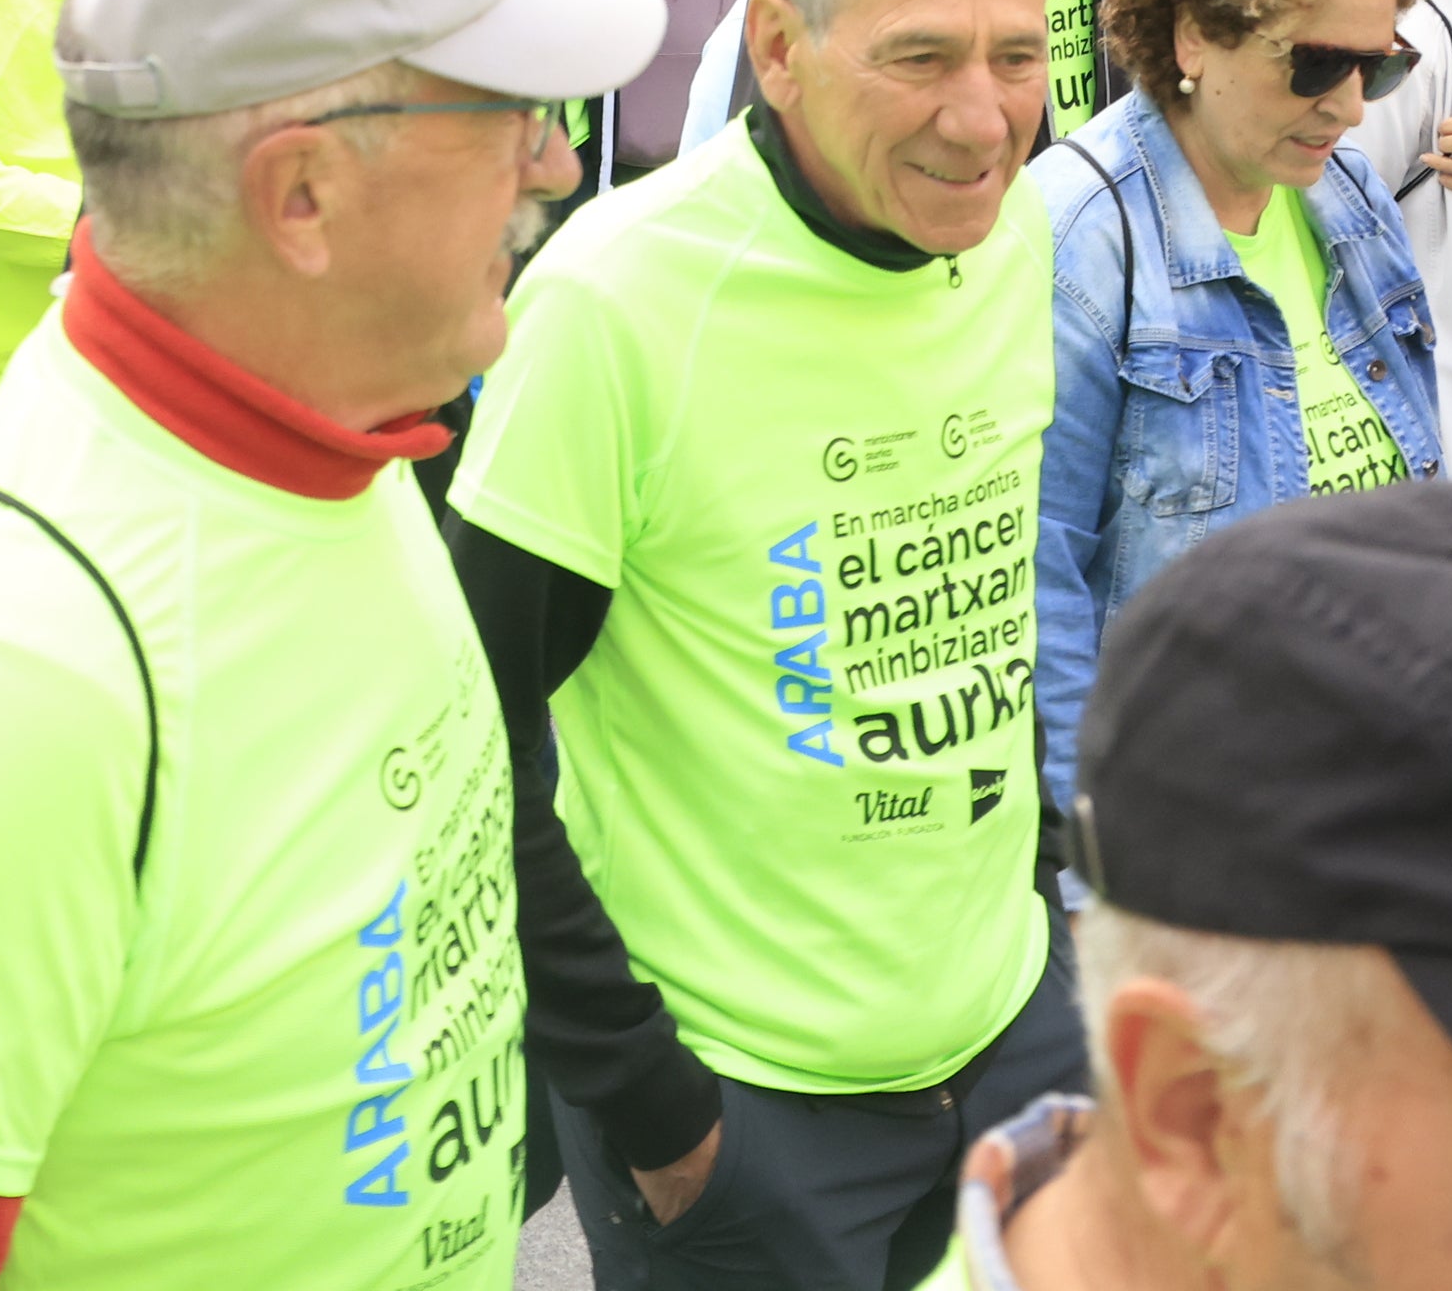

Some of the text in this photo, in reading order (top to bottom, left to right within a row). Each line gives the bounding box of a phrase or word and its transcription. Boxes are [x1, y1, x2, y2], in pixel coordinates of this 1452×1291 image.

[1327, 415, 1383, 459] cán
[833, 469, 1021, 539] En marcha contra
[838, 505, 1025, 590] el cáncer
[768, 520, 844, 768] ARABA
[844, 556, 1026, 648] martxan
[853, 658, 1034, 763] aurka
[855, 786, 933, 825] Vital
[343, 878, 414, 1208] ARABA
[419, 1193, 491, 1271] Vital
